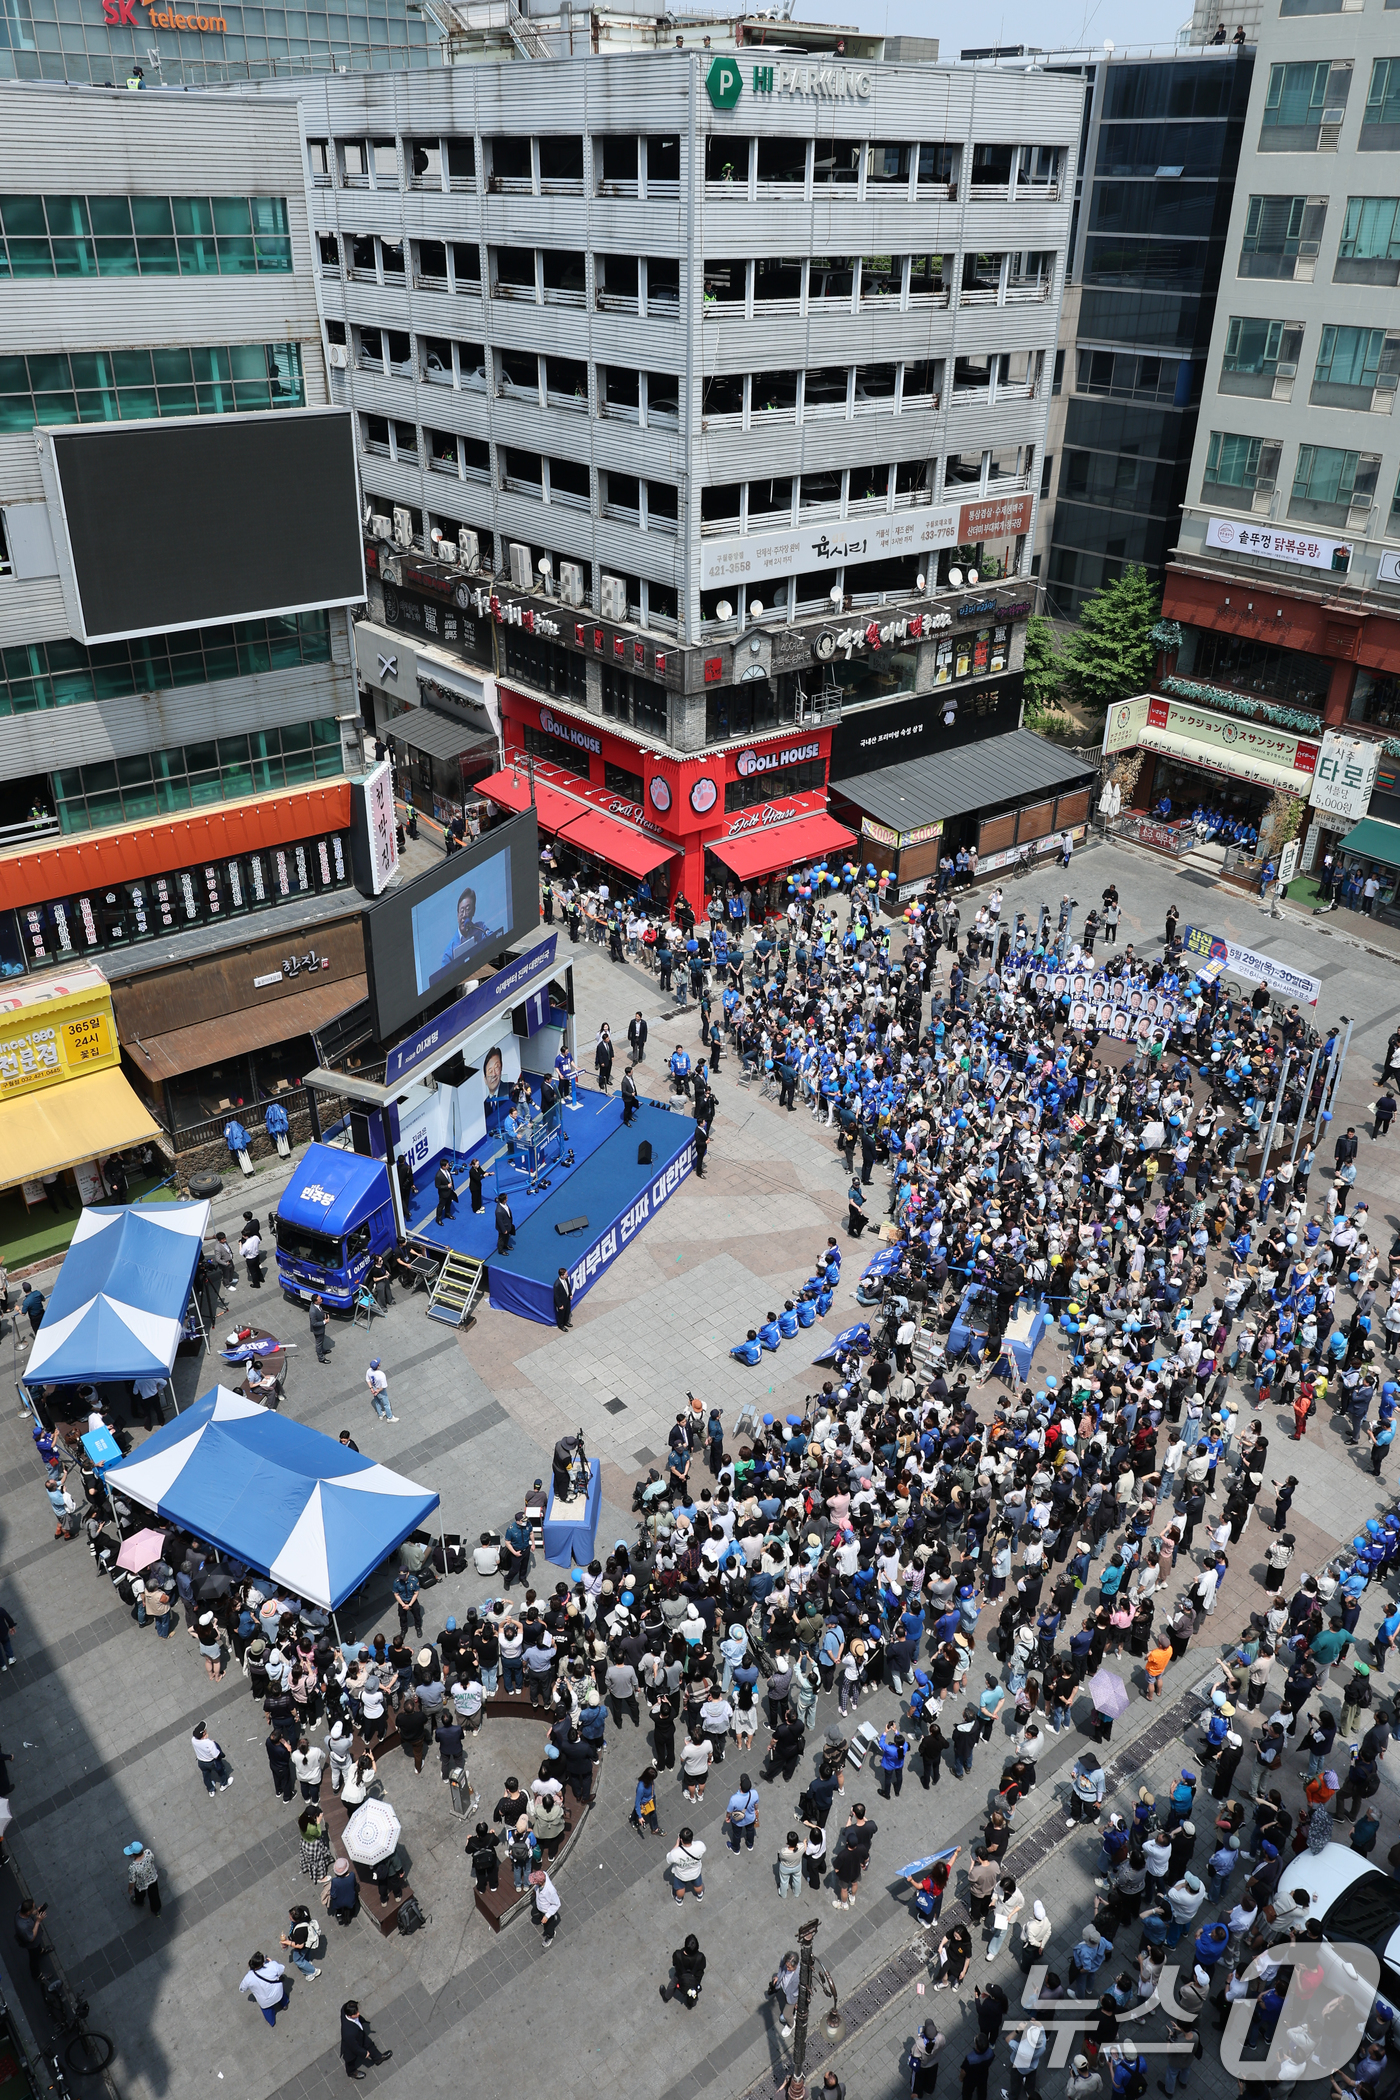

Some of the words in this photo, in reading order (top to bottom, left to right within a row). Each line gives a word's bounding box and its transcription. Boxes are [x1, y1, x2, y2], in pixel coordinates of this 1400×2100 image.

[102, 0, 139, 25] SK
[149, 7, 227, 32] telecom
[719, 70, 734, 96] P
[752, 66, 774, 92] HI
[920, 527, 955, 541] 433-7765
[967, 525, 983, 536] 산더미
[1238, 530, 1271, 549] 솥뚜껑
[1274, 537, 1319, 558] 닭볶음탕
[709, 561, 751, 577] 421-3558
[547, 719, 570, 741] DOLL
[570, 730, 600, 754] HOUSE
[859, 737, 877, 747] 국내산
[1169, 711, 1222, 732] アックジョン
[1239, 731, 1295, 753] スサンシザン
[747, 755, 779, 774] DOLL
[780, 742, 819, 765] HOUSE
[1335, 748, 1355, 761] 사주
[1318, 757, 1363, 789] 타로
[1315, 794, 1353, 814] 5,000원
[609, 800, 633, 817] Doll
[634, 808, 663, 834] House
[728, 813, 759, 836] Doll
[762, 804, 796, 825] House
[1281, 848, 1294, 878] 타로
[1187, 939, 1211, 958] 투표
[1189, 928, 1213, 947] 사전
[282, 950, 319, 977] 한잔
[1229, 948, 1242, 960] 5월
[495, 973, 518, 994] 이제부터
[517, 963, 529, 980] 진짜
[529, 949, 550, 970] 대한민국
[1283, 984, 1310, 1001] 사전투표소
[533, 992, 543, 1026] 1
[68, 1017, 100, 1035] 365일
[74, 1033, 99, 1048] 24시
[397, 1052, 403, 1069] 1
[415, 1029, 439, 1055] 이재명
[0, 1042, 58, 1078] 전문점
[80, 1047, 99, 1060] 꽃집
[2, 1078, 20, 1088] 구월점
[21, 1067, 61, 1083] 032.421.0445
[412, 1126, 427, 1143] 지금은
[300, 1187, 335, 1206] 민주당
[569, 1227, 617, 1296] 제부터
[620, 1192, 649, 1243] 진짜
[346, 1268, 352, 1279] 1
[353, 1255, 371, 1275] 이재명
